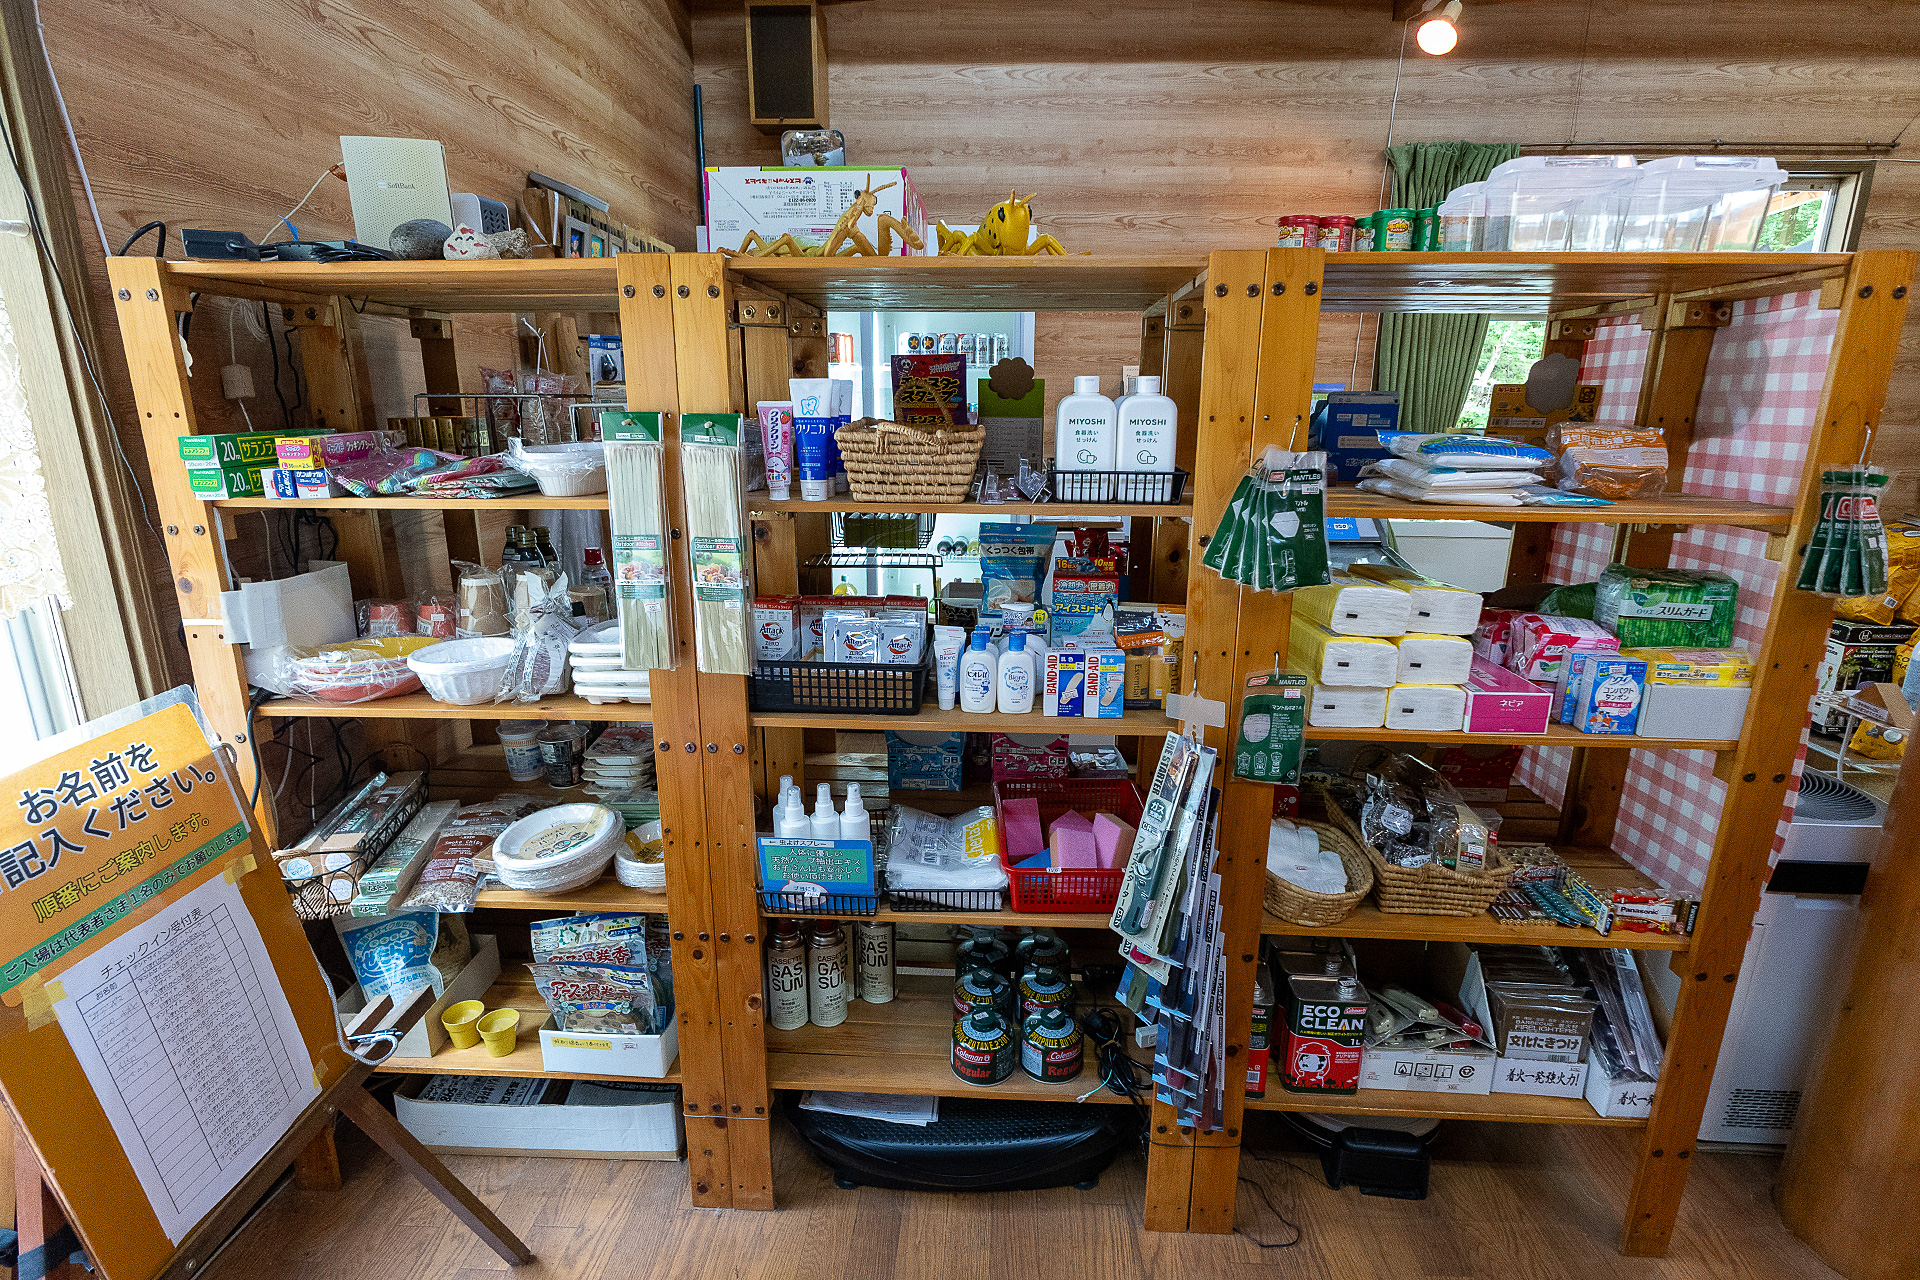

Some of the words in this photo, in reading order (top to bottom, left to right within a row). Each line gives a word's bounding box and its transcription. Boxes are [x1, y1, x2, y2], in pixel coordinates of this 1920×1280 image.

[796, 424, 826, 435] クリニカ
[986, 546, 1035, 555] くっつく包帯
[1055, 604, 1103, 613] アイスシート
[1655, 606, 1708, 618] スリムガード
[759, 624, 785, 636] Attack
[887, 641, 913, 653] Attack
[1133, 665, 1142, 699] Essential
[1603, 687, 1634, 695] コンパクト
[1151, 755, 1174, 795] STARTER
[18, 741, 160, 826] お名前を
[1149, 801, 1166, 812] ガス
[0, 765, 217, 891] 記入ください。
[788, 848, 843, 857] 人体に優しい
[31, 811, 211, 923] 順番にご案内します。
[771, 856, 861, 865] 天然ハーブ抽出エキス
[772, 864, 862, 874] お子さんにも安心して
[1620, 906, 1659, 915] Panasonic
[101, 907, 203, 980] チェックイン受付表
[771, 962, 803, 979] GAS
[772, 975, 804, 993] SUN
[1302, 1004, 1341, 1018] ECO
[1300, 1017, 1364, 1031] CLEAN
[1514, 1025, 1579, 1034] FIRELIGHTERS
[967, 1040, 994, 1051] BUTANE
[1028, 1031, 1058, 1048] PROPANE
[1509, 1034, 1580, 1050] 文化たきつけ
[955, 1046, 985, 1062] Coleman
[955, 1058, 992, 1078] Regular
[1505, 1068, 1580, 1087] 着火一発強火力!
